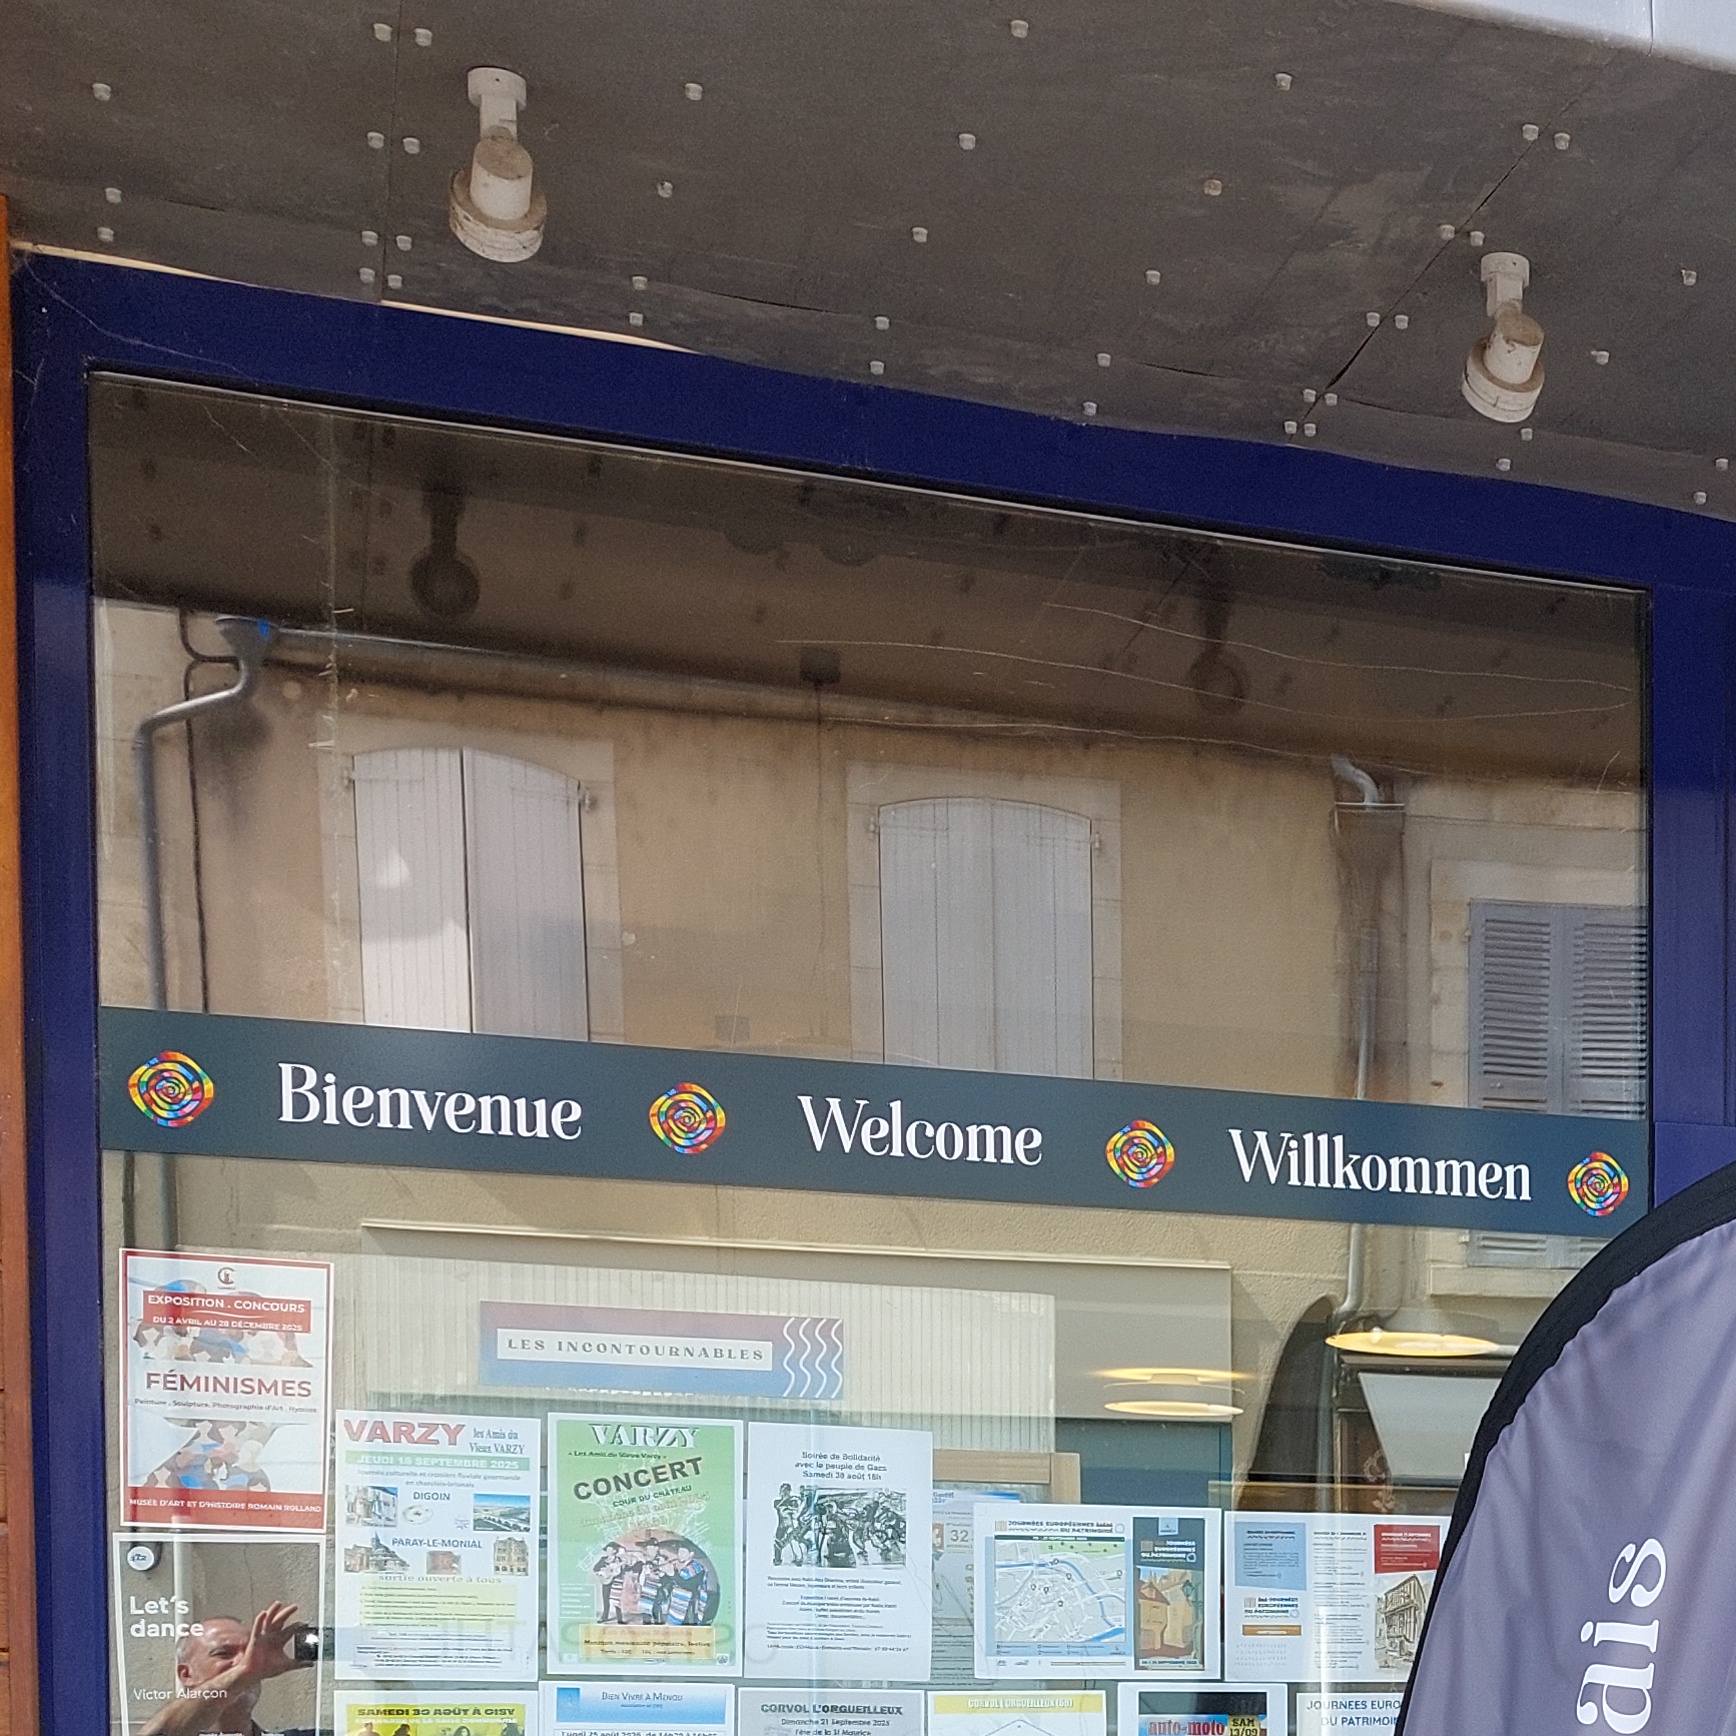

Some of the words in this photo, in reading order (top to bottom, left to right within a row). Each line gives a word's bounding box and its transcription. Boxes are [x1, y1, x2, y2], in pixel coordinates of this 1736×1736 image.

[279, 1062, 582, 1141] Bienvenue
[798, 1095, 1043, 1166] Welcome
[1229, 1128, 1532, 1201] Willkommen
[148, 1295, 224, 1309] EXPOSITION
[234, 1300, 305, 1313] CONCOURS
[507, 1338, 545, 1351] LES
[558, 1340, 764, 1361] INCONTOURNABLES
[146, 1370, 312, 1398] FÉMINISMES
[344, 1419, 465, 1446] VARZY
[474, 1428, 483, 1438] les
[485, 1429, 505, 1439] Amis
[507, 1430, 518, 1439] du
[589, 1424, 699, 1448] VARZY
[469, 1442, 492, 1453] Vieux
[494, 1443, 525, 1454] VARZY
[358, 1455, 394, 1464] JEUDI
[397, 1457, 413, 1465] 18
[416, 1458, 487, 1468] SEPTEMBRE
[491, 1460, 519, 1469] 2025
[573, 1457, 703, 1500] CONCERT
[413, 1491, 450, 1501] DIGOIN
[391, 1538, 482, 1548] PARAY-LE-MONIAL
[130, 1596, 189, 1614] Let's
[130, 1619, 204, 1637] dance
[761, 1704, 809, 1713] CORVOL
[813, 1704, 903, 1715] L'ORGUEILLEUX
[1149, 1720, 1225, 1735] auto-moto
[1232, 1719, 1255, 1727] SAM
